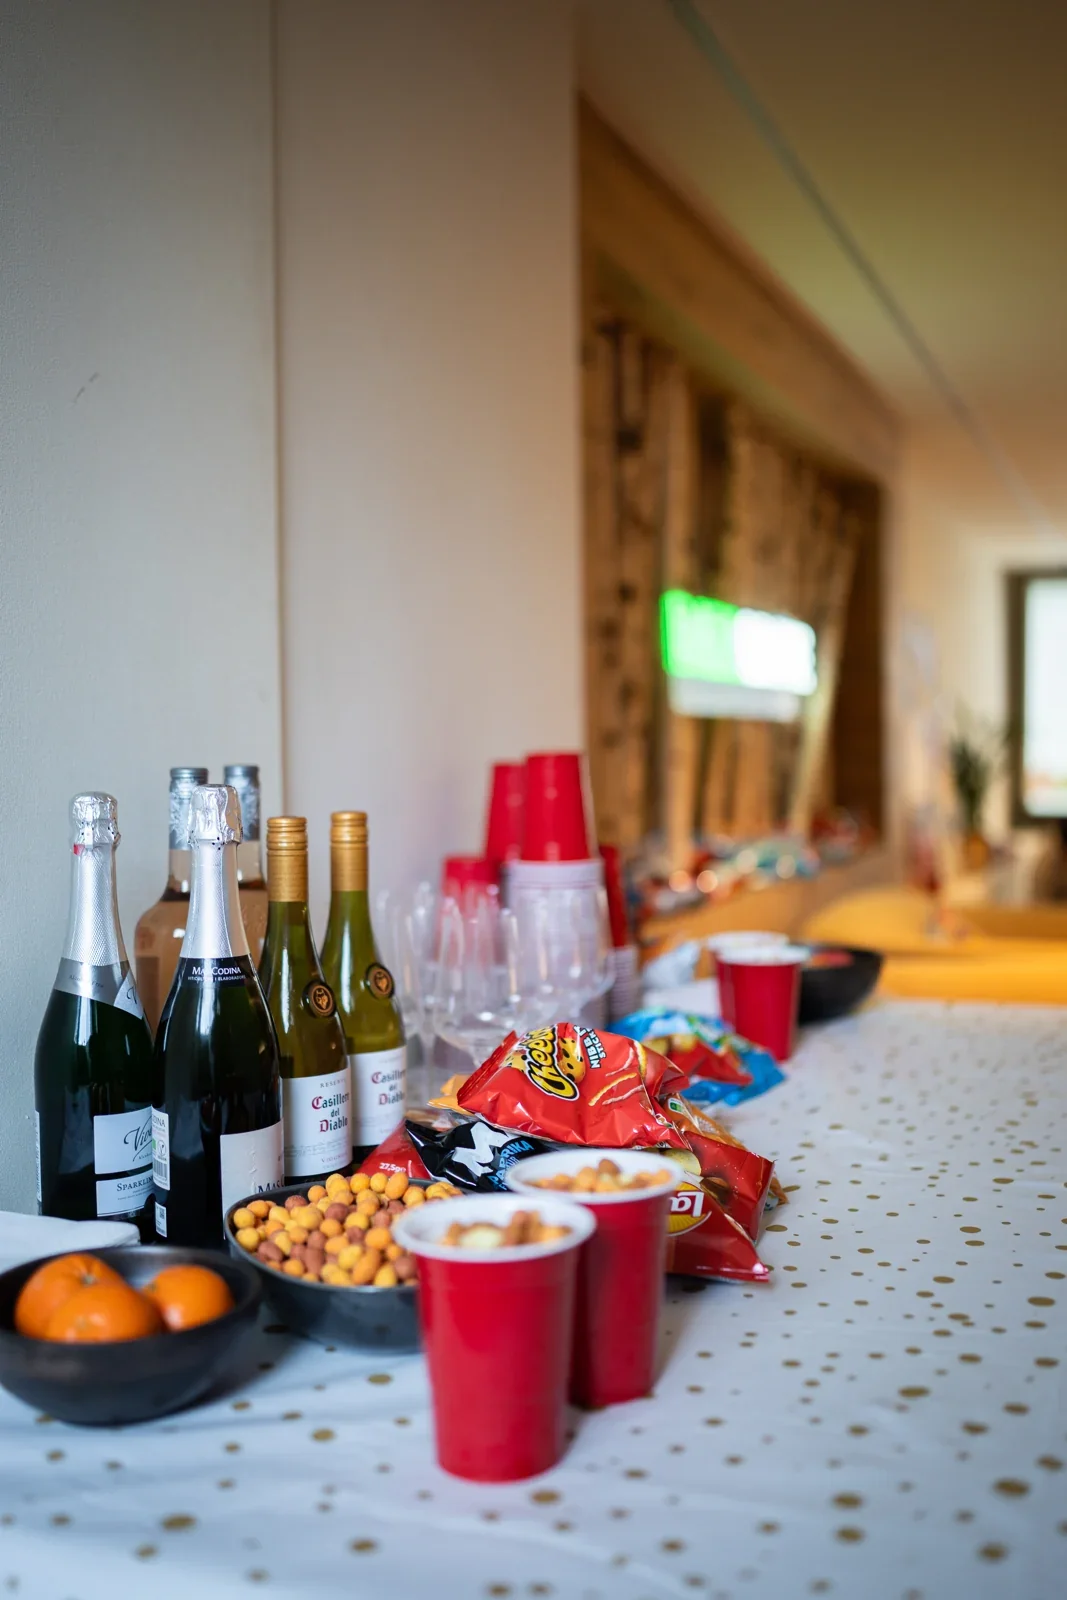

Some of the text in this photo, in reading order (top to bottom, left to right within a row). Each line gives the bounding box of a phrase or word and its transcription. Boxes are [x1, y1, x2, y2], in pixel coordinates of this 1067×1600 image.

[586, 1028, 607, 1060] STICK
[319, 1116, 348, 1132] Diablo
[330, 1107, 339, 1118] del
[487, 1140, 535, 1185] PAPRIKA
[669, 1191, 705, 1218] La
